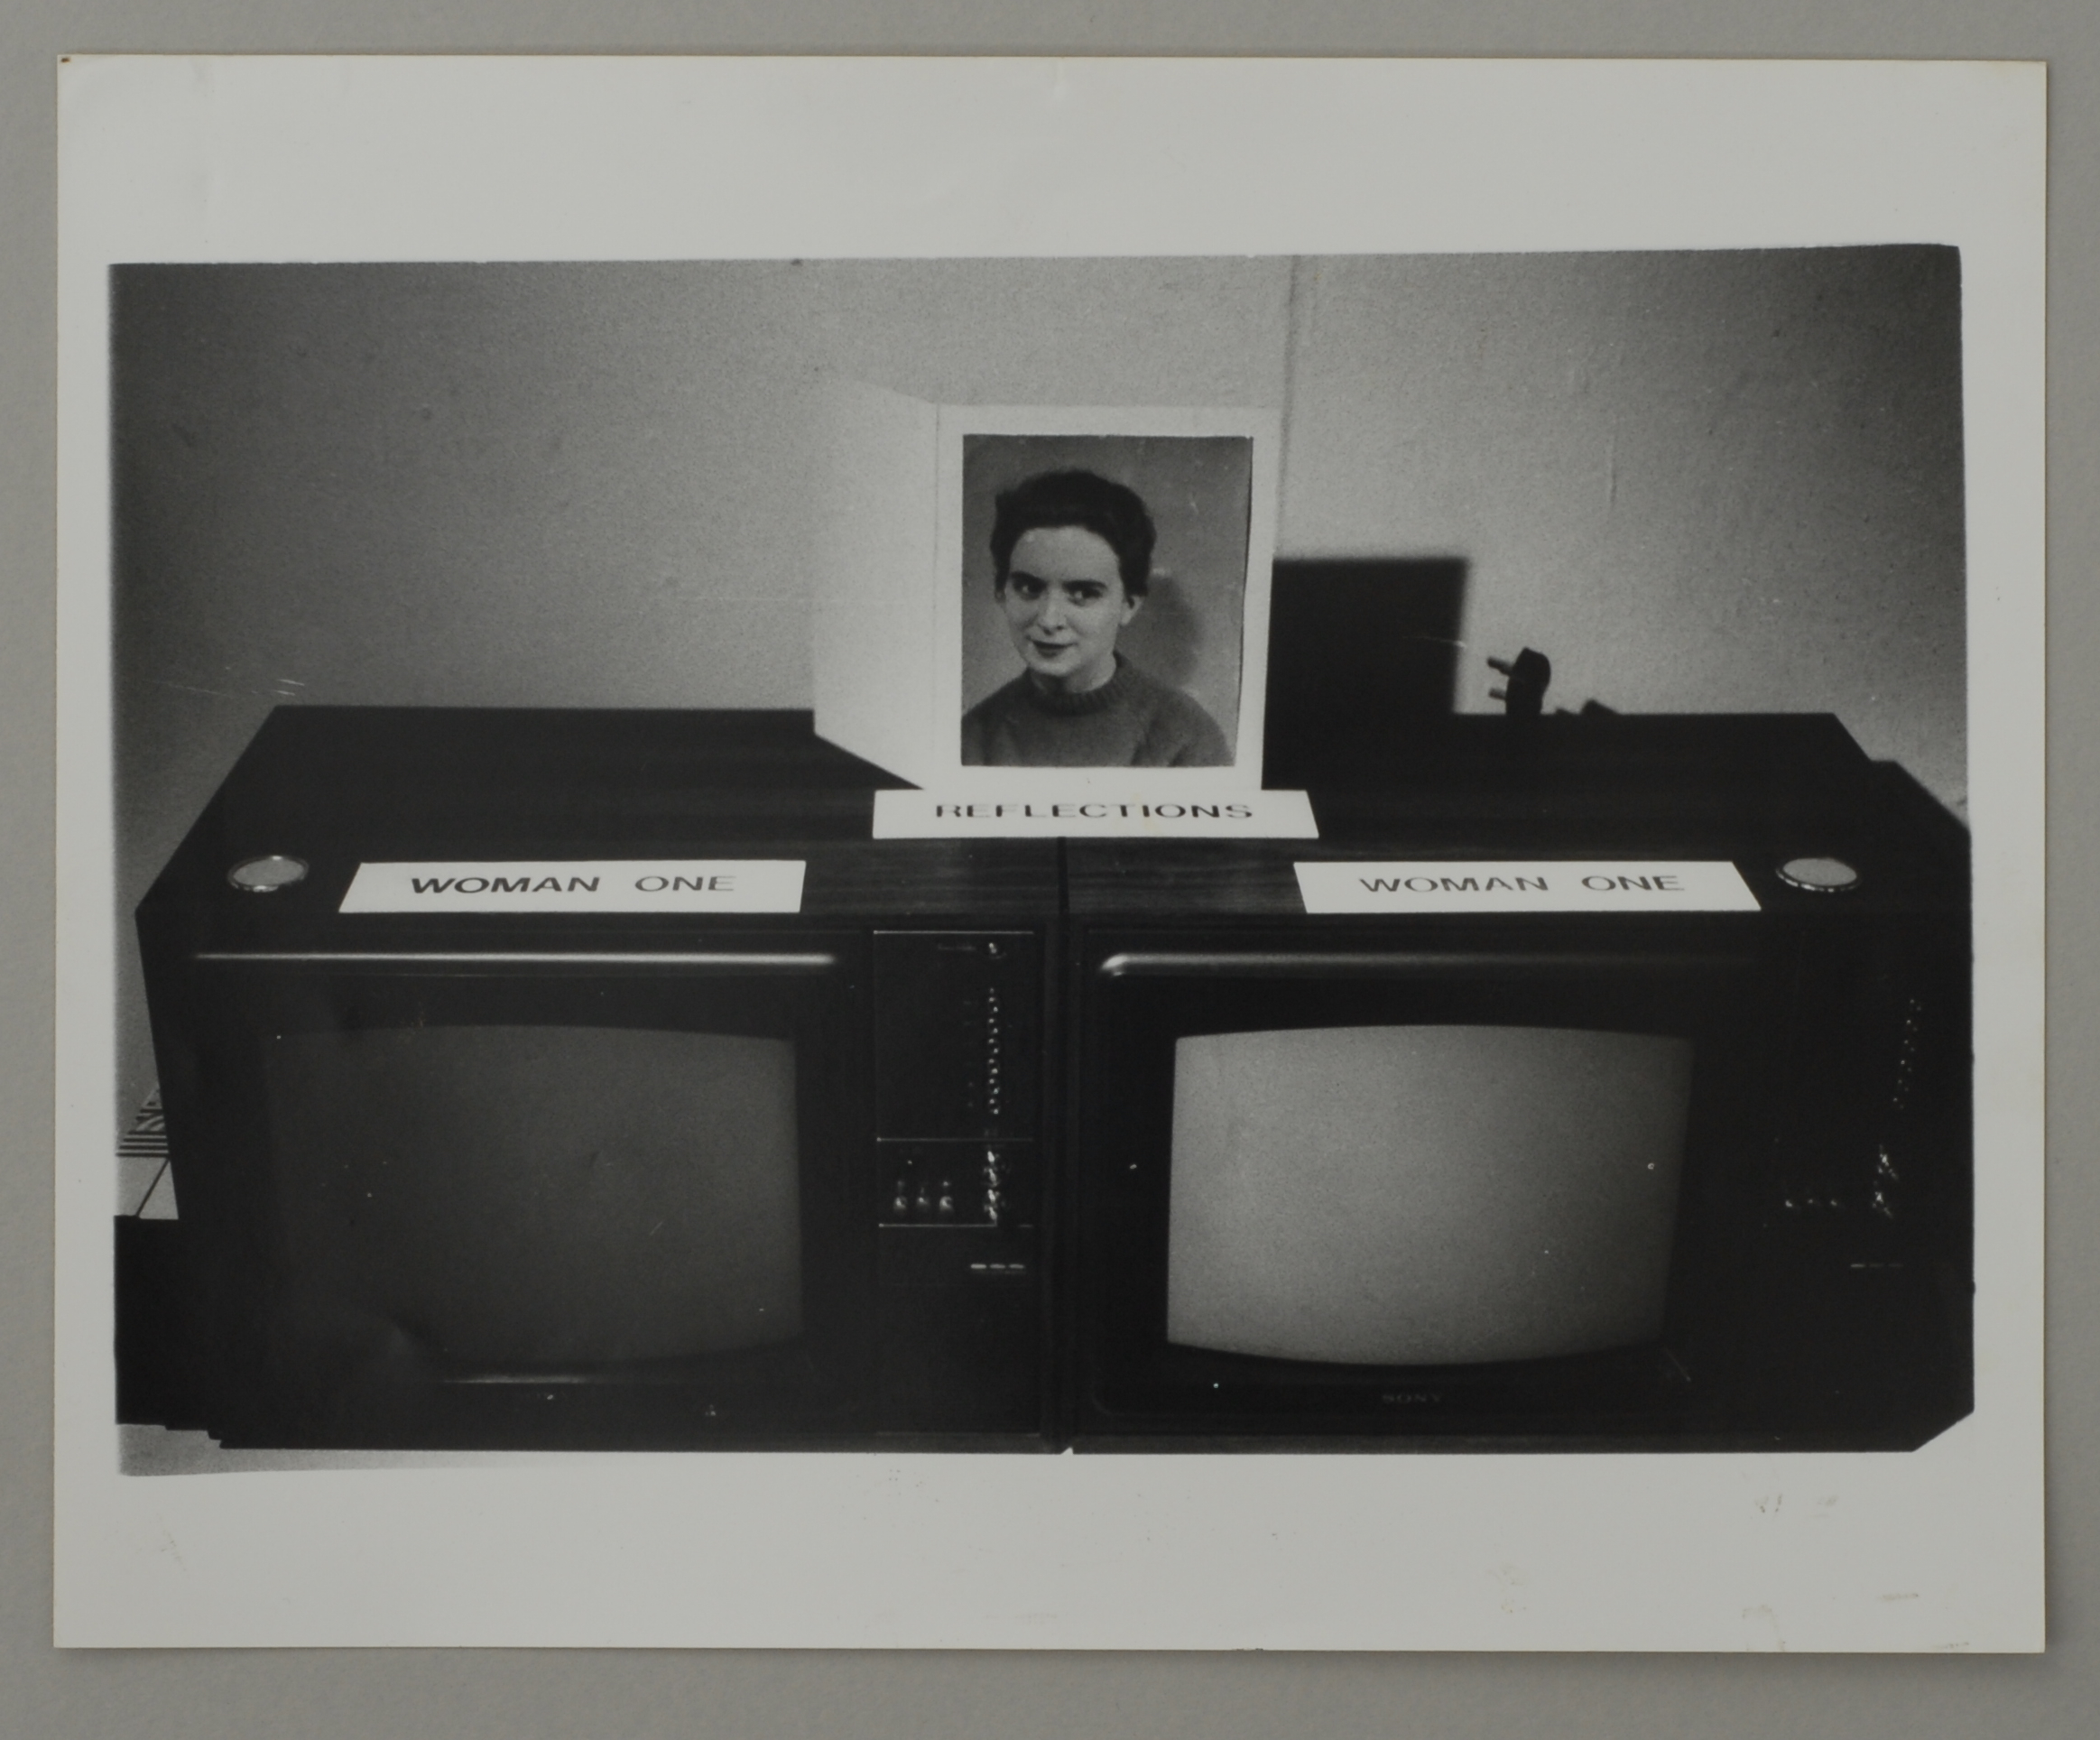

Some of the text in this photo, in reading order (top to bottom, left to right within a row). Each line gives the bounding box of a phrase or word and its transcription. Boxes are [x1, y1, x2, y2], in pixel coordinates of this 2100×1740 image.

[936, 803, 1253, 819] REFLECTIONS
[412, 876, 735, 894] WOMAN ONE
[1359, 875, 1683, 893] WOMAN ONE
[1382, 1393, 1442, 1404] SONY
